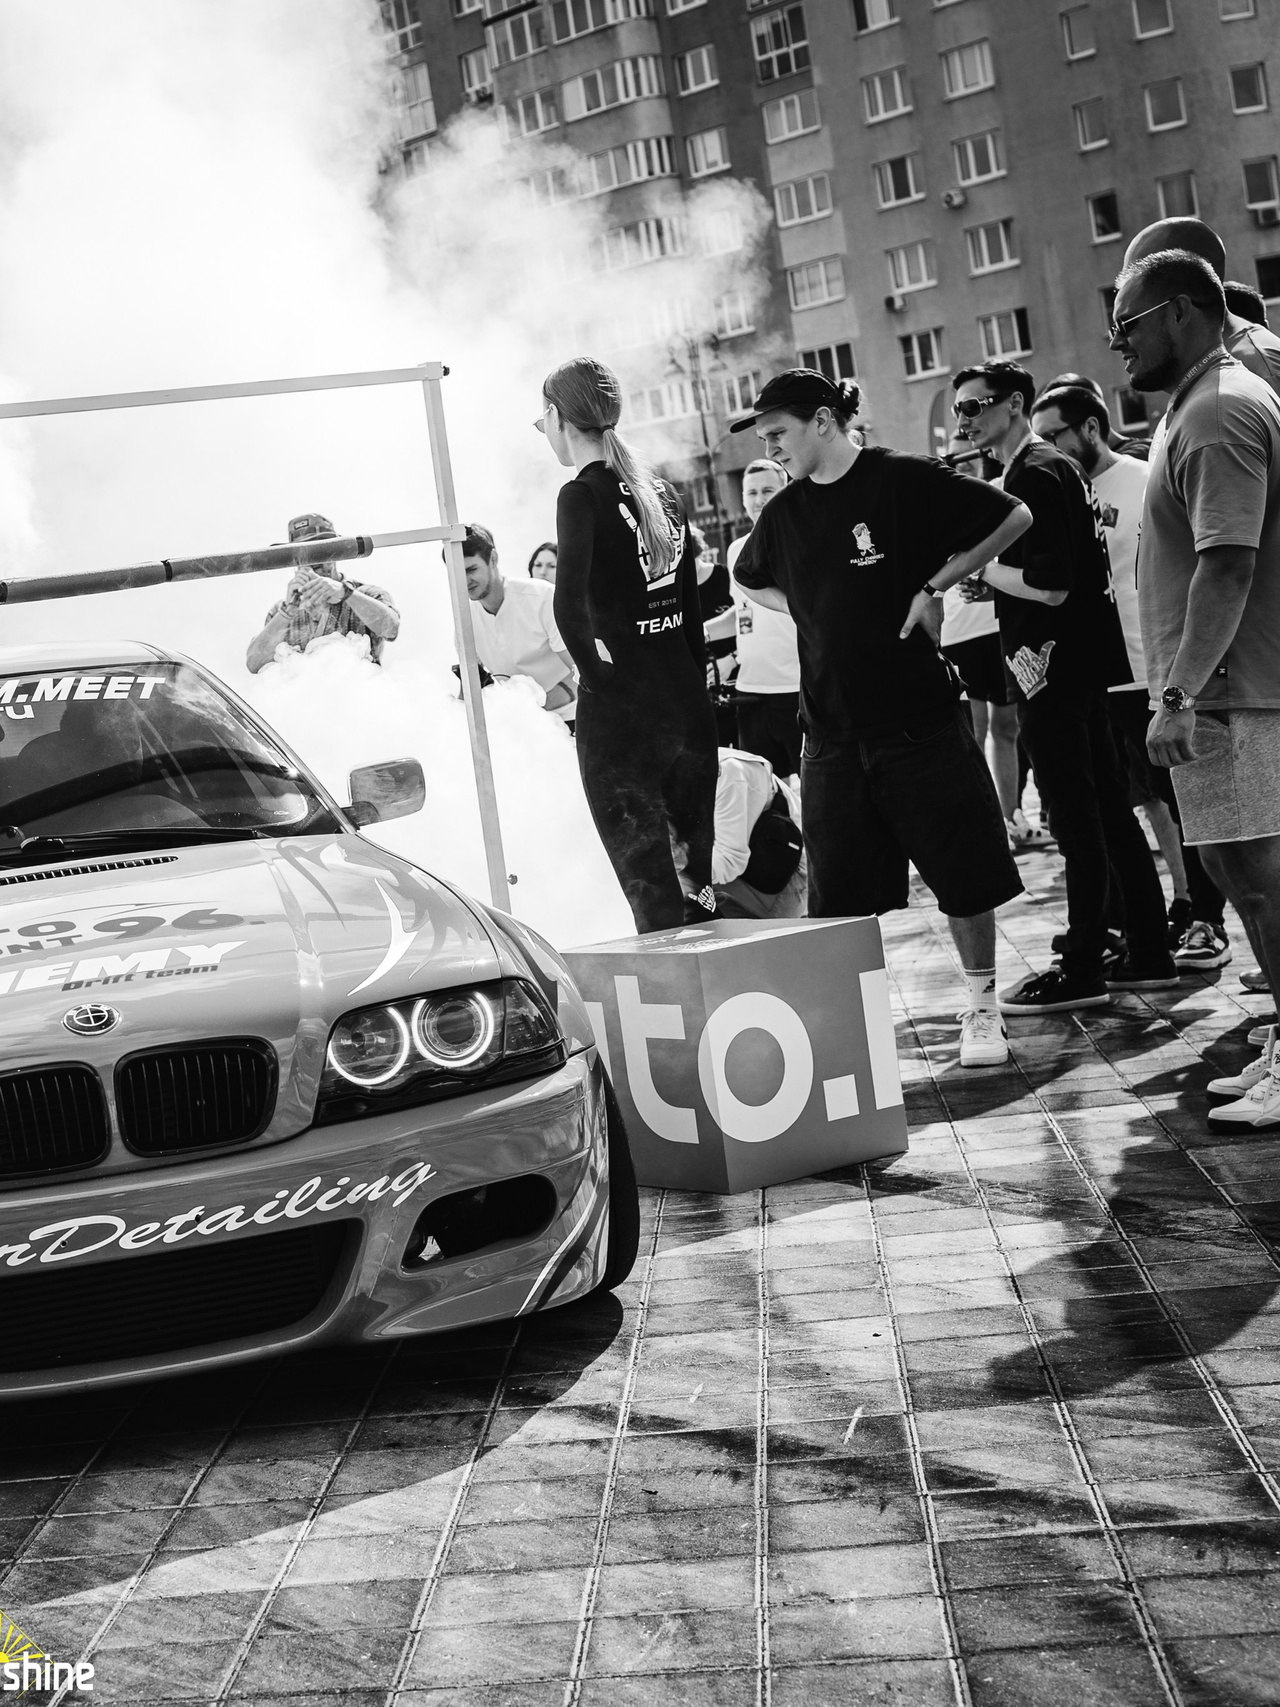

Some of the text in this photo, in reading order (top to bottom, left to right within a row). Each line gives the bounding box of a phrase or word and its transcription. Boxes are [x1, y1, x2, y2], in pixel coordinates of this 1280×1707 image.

[636, 611, 683, 635] TEAM
[61, 965, 218, 992] Drift team
